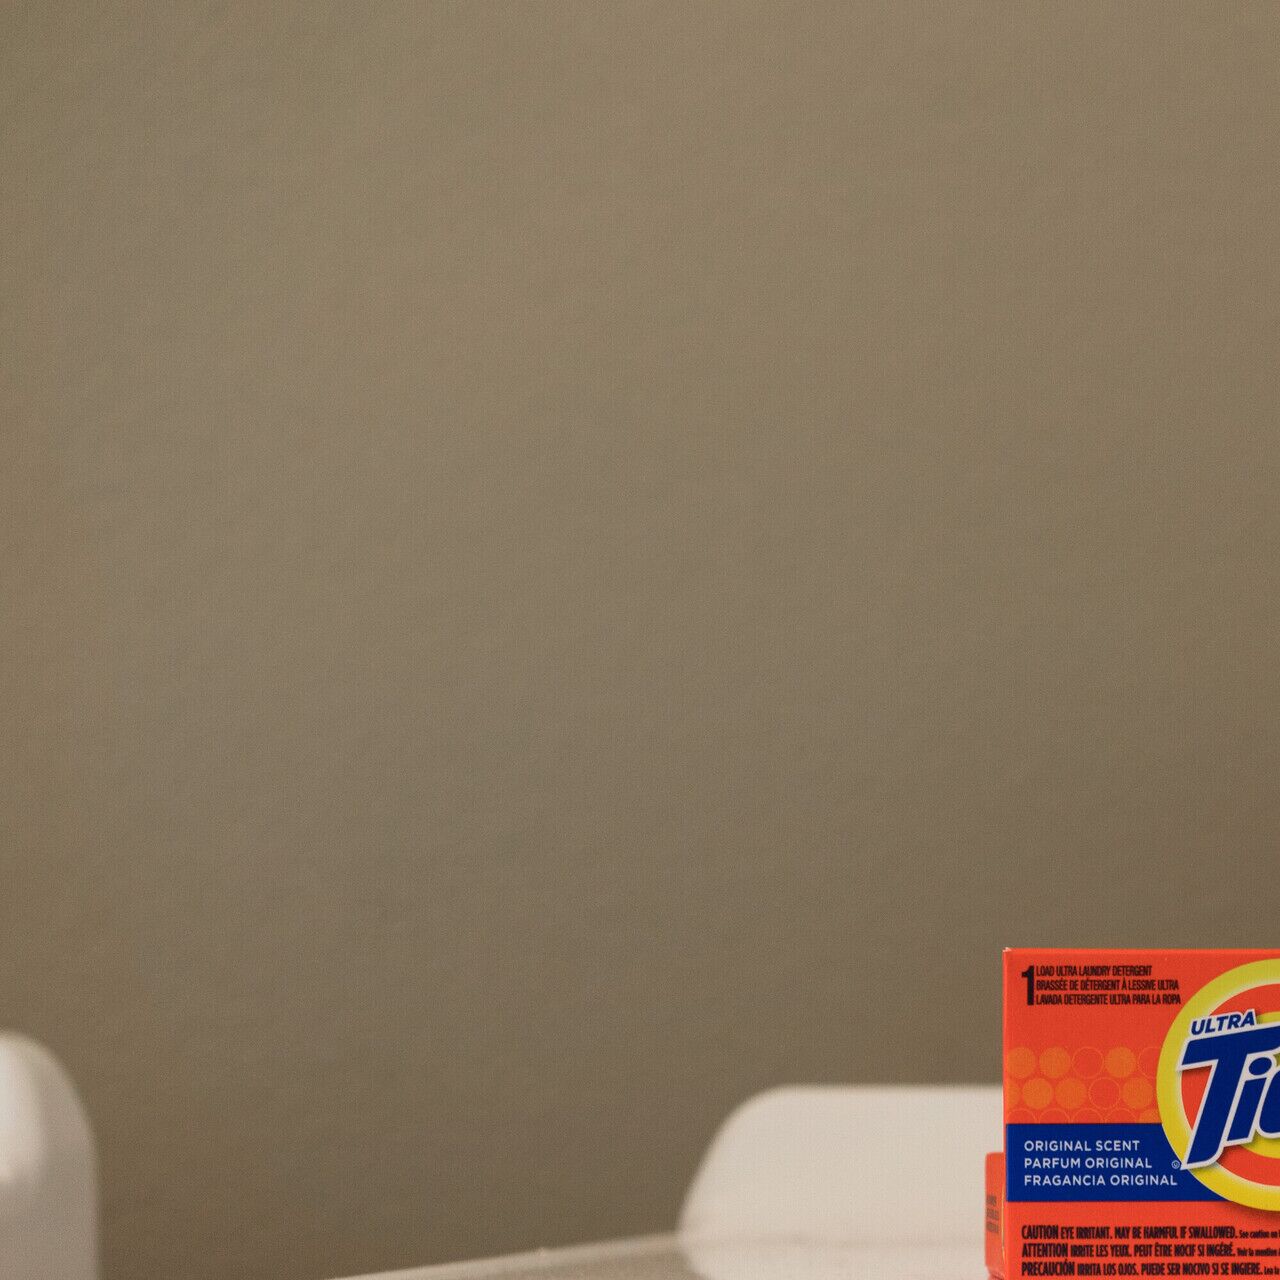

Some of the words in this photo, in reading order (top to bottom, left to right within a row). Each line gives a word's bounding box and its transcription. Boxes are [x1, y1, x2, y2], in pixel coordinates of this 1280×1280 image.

[1036, 965, 1055, 976] LOAD
[1056, 965, 1077, 976] ULTRA
[1079, 965, 1111, 976] LAUNDRY
[1112, 965, 1152, 976] DETERGENT
[1021, 965, 1034, 1005] 1
[1191, 1011, 1255, 1035] ULTRA
[1024, 1140, 1091, 1151] ORIGINAL
[1096, 1140, 1140, 1151] SCENT
[1024, 1157, 1081, 1169] PARFUM
[1085, 1157, 1152, 1169] ORIGINAL
[1024, 1175, 1105, 1186] FRAGANCIA
[1110, 1175, 1178, 1186] ORIGINAL
[1021, 1225, 1058, 1239] CAUTION
[1060, 1226, 1075, 1239] EYE
[1076, 1226, 1112, 1239] IRRITANT.
[1115, 1226, 1131, 1239] MAY
[1132, 1226, 1142, 1239] BE
[1143, 1226, 1178, 1239] HARMFUL
[1180, 1226, 1187, 1239] IF
[1188, 1226, 1238, 1239] SWALLOWED.
[1021, 1259, 1075, 1276] PRECAUCIÓN
[1077, 1263, 1101, 1275] IRRITA
[1103, 1263, 1116, 1275] LOS
[1118, 1263, 1139, 1275] OJOS.
[1141, 1263, 1165, 1275] PUEDE
[1167, 1263, 1181, 1275] SER
[1182, 1263, 1210, 1275] NOCIVO
[1212, 1263, 1219, 1275] SI
[1220, 1263, 1229, 1275] SE
[1231, 1263, 1263, 1275] INGIERE.
